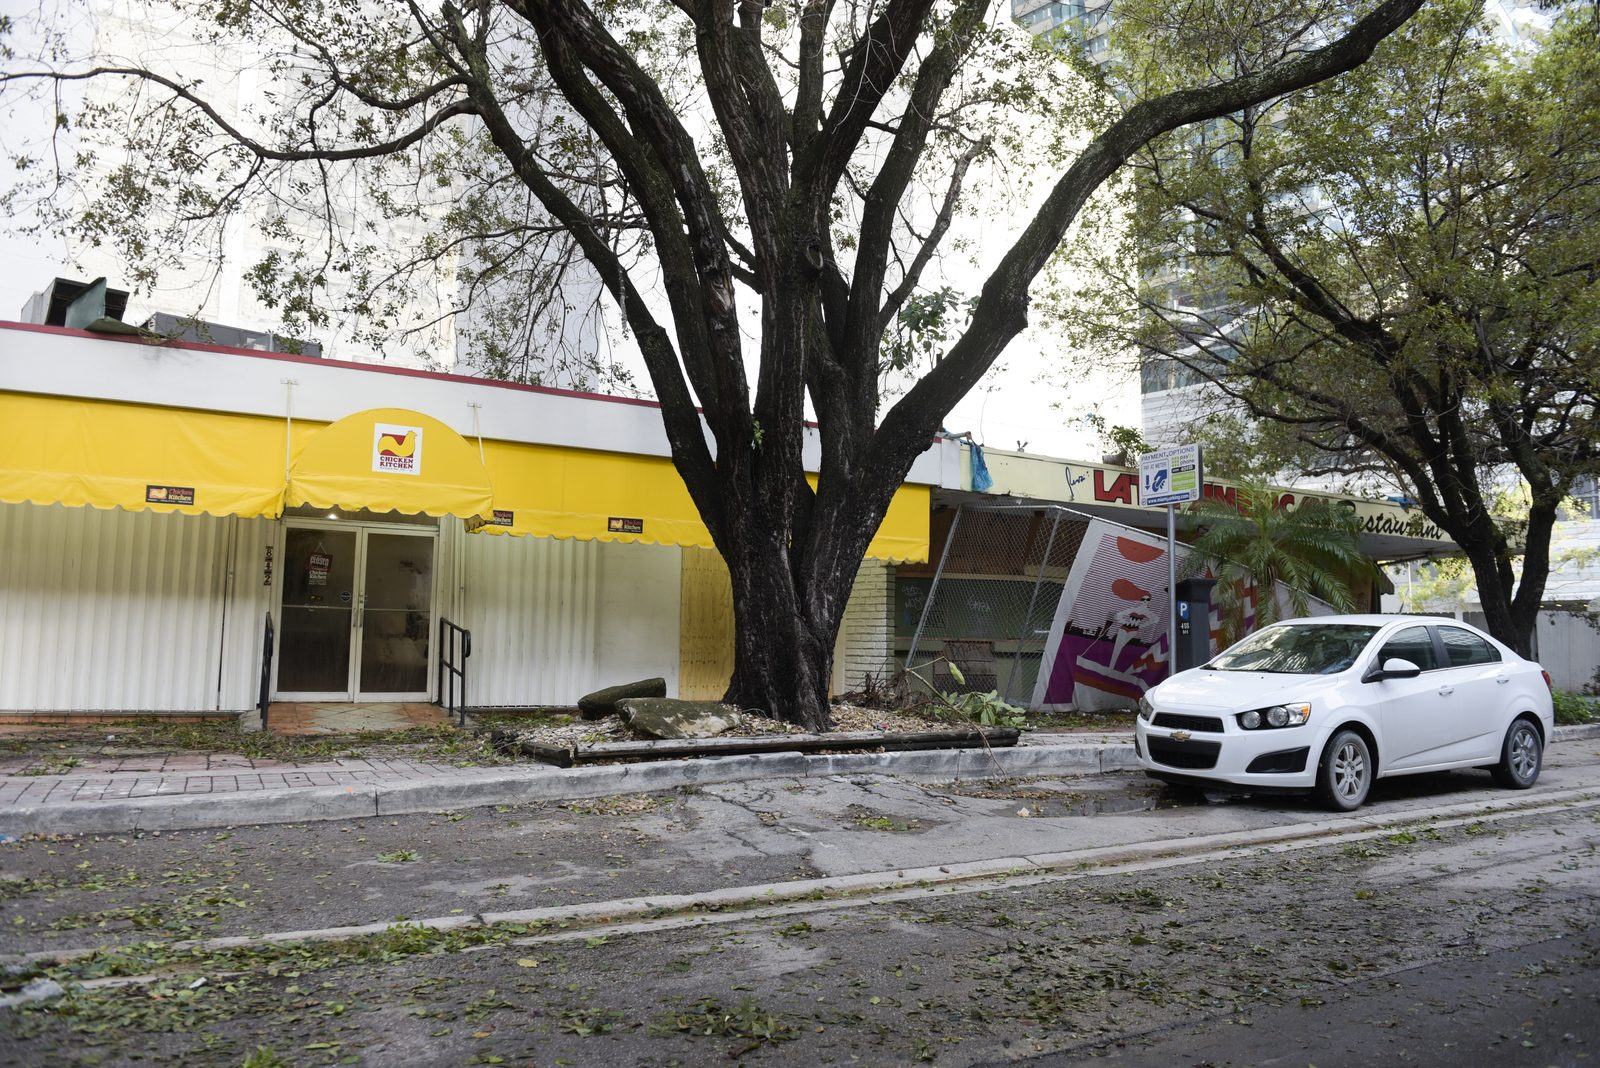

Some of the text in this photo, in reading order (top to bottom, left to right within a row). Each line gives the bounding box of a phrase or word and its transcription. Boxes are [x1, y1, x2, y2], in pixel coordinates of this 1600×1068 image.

[1141, 447, 1195, 461] PAYMENT OPTIONS
[380, 456, 414, 464] CHICKEN
[379, 461, 414, 470] KITCHEN
[169, 488, 193, 496] Chicken
[168, 494, 192, 502] Kitchen
[1180, 602, 1188, 617] P
